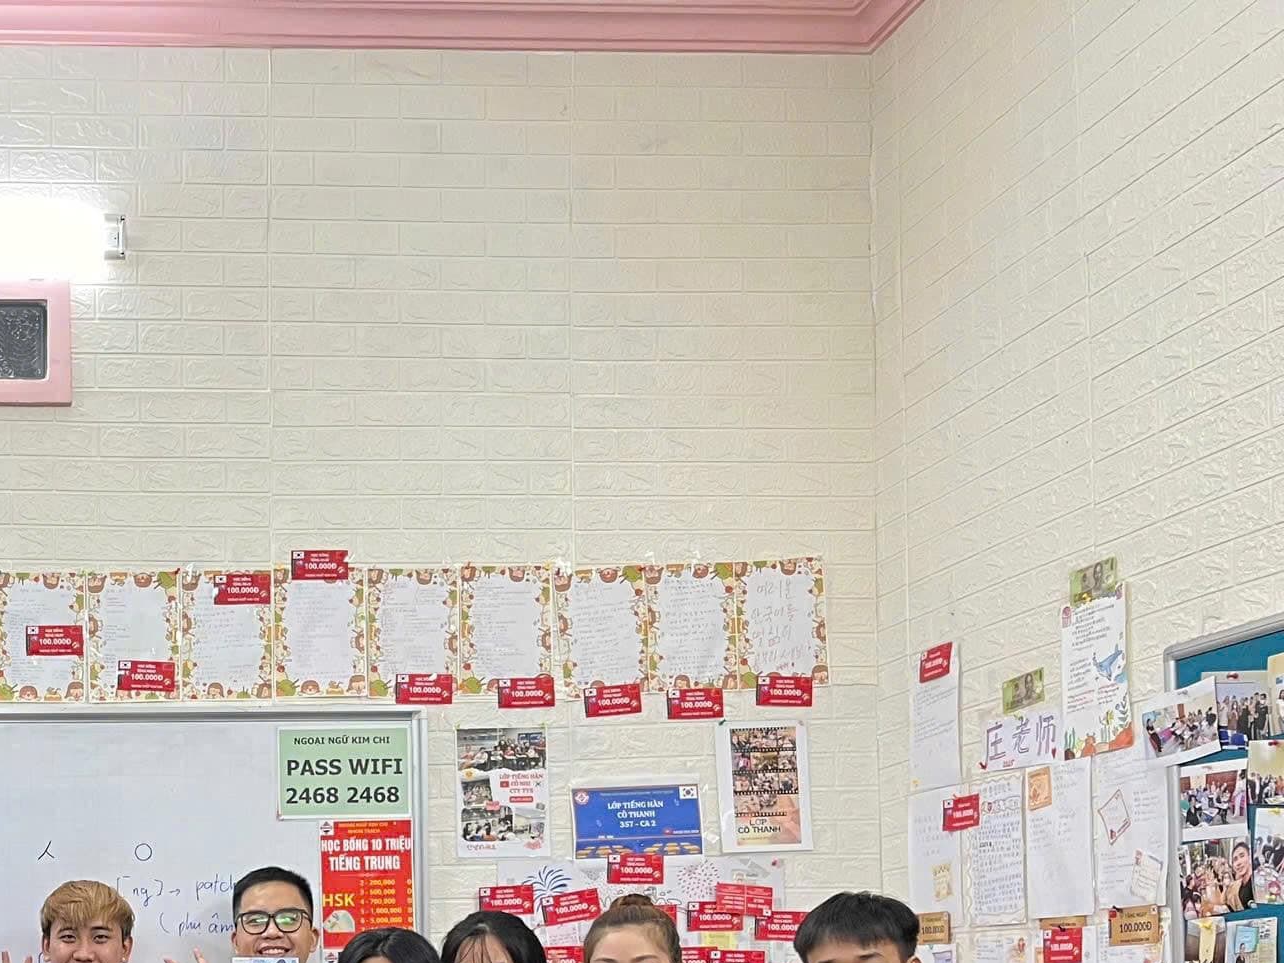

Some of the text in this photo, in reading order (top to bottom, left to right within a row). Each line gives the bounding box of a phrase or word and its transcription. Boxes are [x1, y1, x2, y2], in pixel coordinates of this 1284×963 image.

[328, 734, 350, 745] NGỮ
[351, 736, 370, 744] KIM
[372, 736, 390, 744] CHI
[286, 758, 403, 776] PASS WIFI
[285, 786, 400, 804] 2468 2468
[623, 799, 647, 809] TIẾNG
[617, 810, 655, 819] CÔ THANH
[321, 839, 340, 854] HỌC
[372, 838, 382, 851] 10
[385, 834, 411, 853] TRIỆU
[329, 852, 401, 871] TIẾNG TRUNG
[322, 893, 355, 908] HSK
